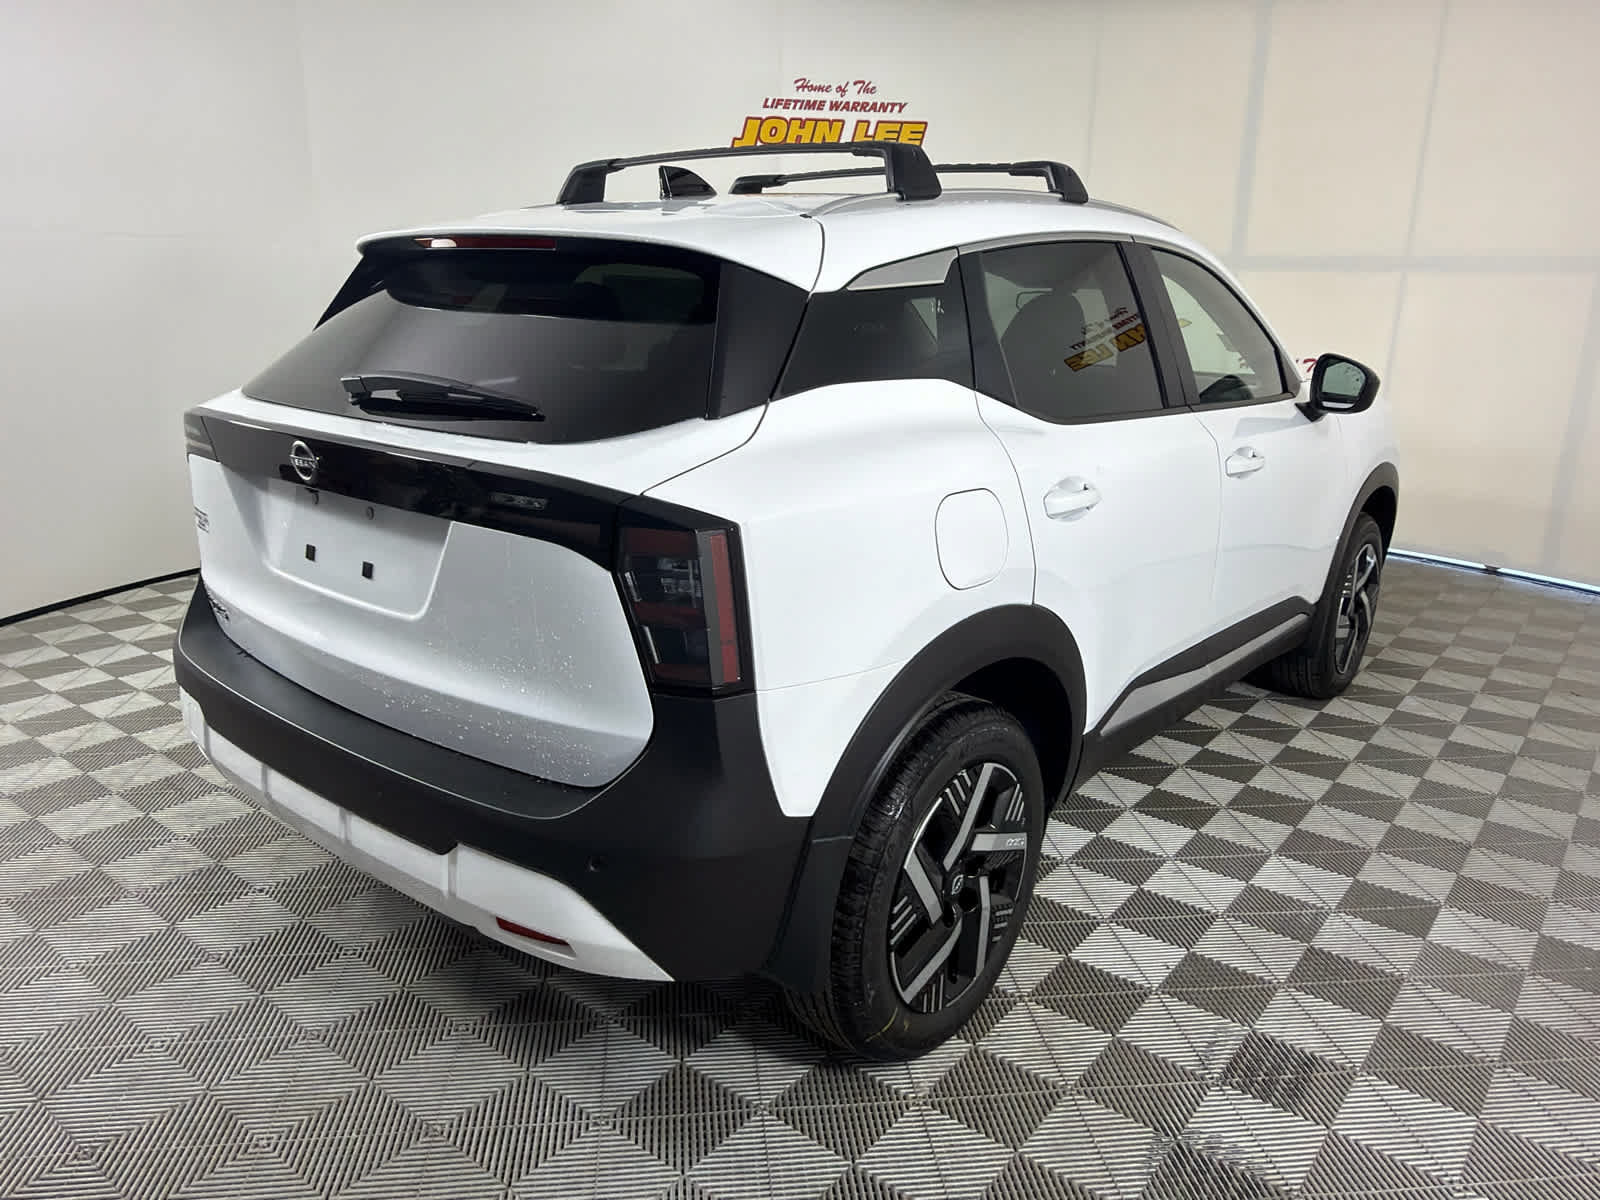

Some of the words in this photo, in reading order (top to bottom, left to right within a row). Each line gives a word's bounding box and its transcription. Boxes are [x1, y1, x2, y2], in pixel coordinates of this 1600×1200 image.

[794, 78, 832, 93] Home
[835, 81, 849, 97] of
[853, 80, 877, 94] The
[762, 98, 826, 111] LIFETIME
[829, 100, 908, 113] WARRANTY
[731, 116, 845, 148] JOHN
[852, 120, 928, 146] LEE
